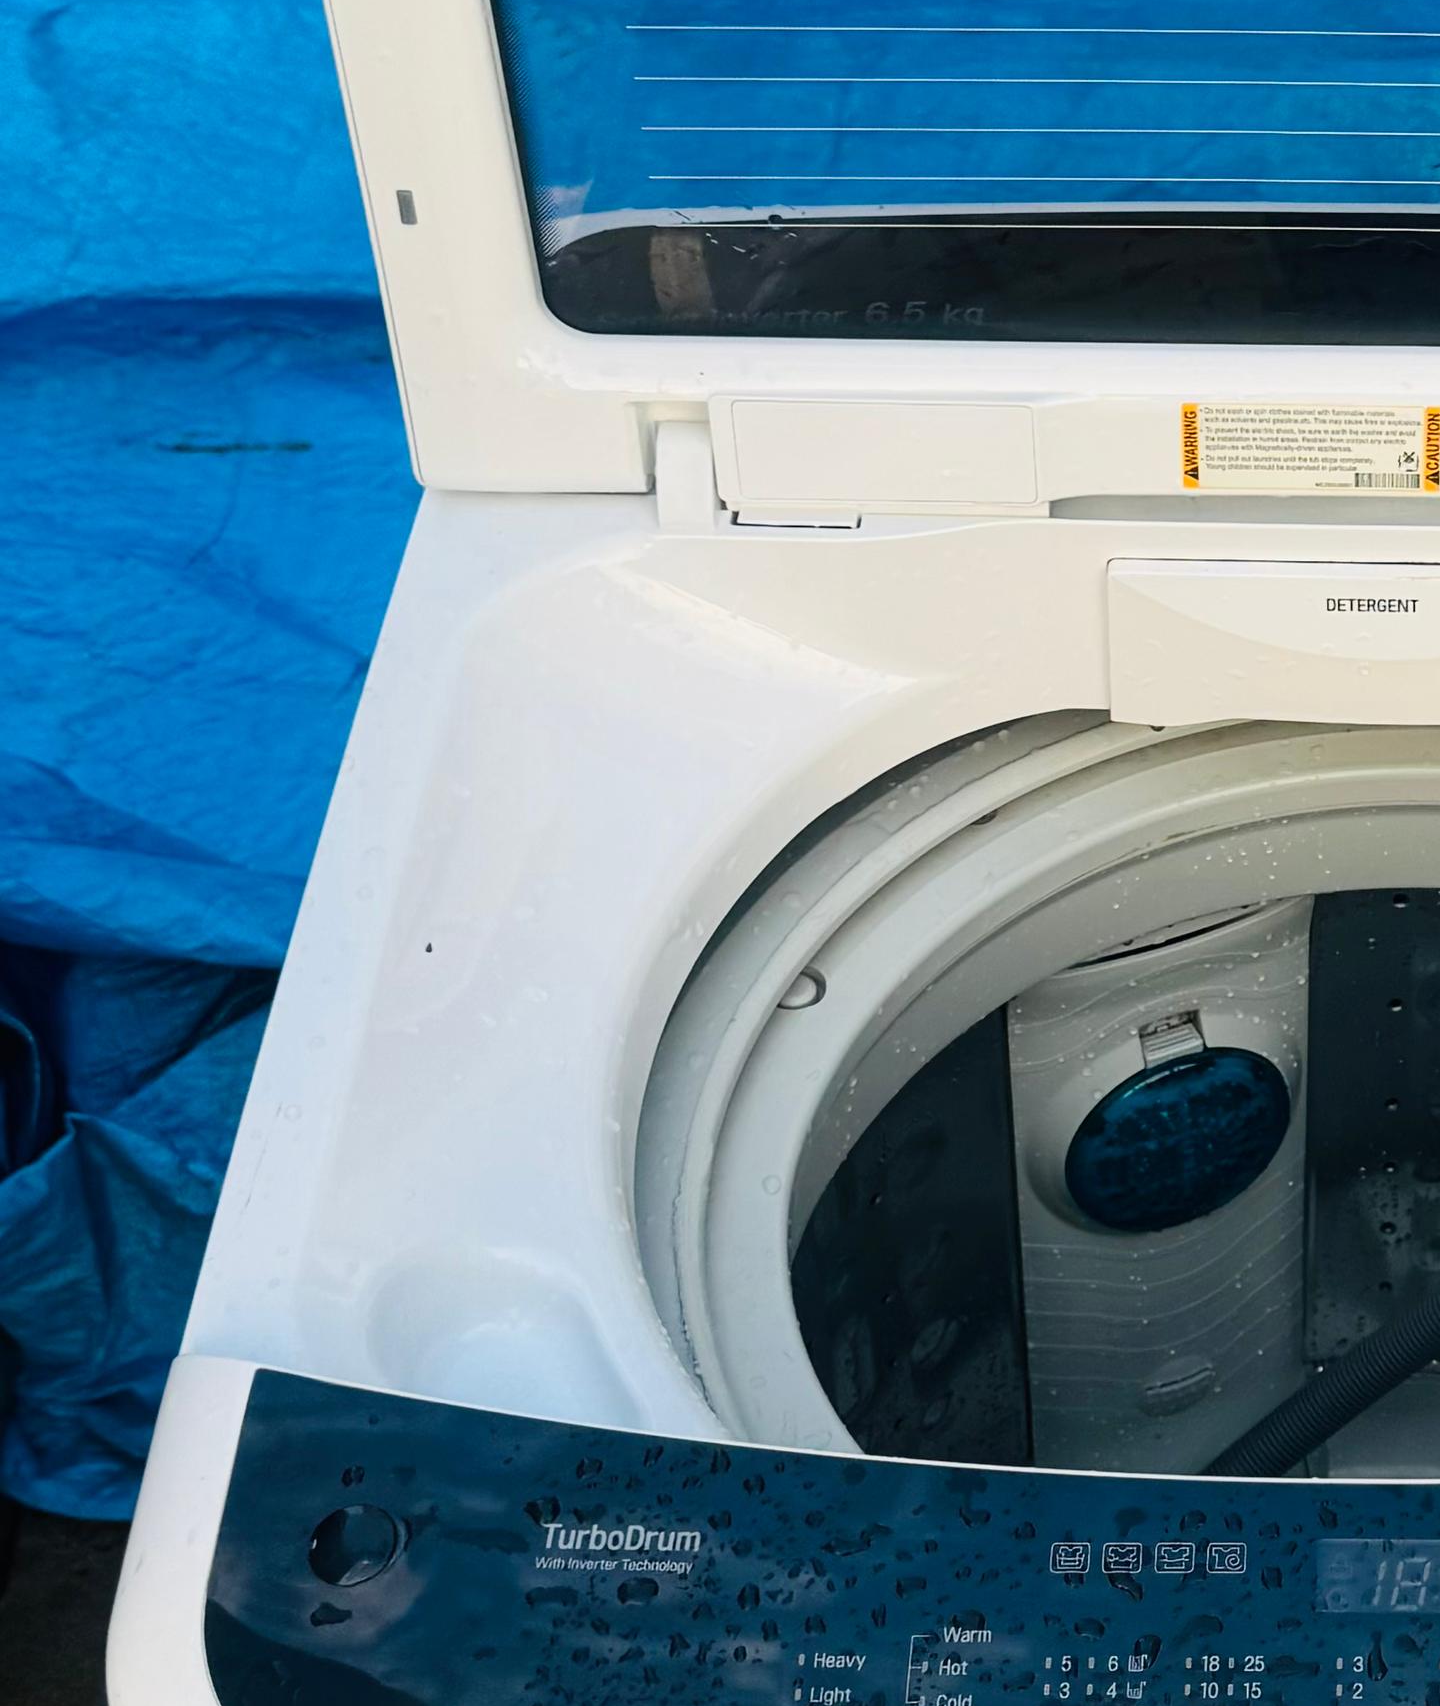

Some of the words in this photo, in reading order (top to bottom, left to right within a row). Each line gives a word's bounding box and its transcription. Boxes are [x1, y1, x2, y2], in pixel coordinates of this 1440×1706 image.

[1184, 410, 1198, 468] WARNING
[1426, 413, 1440, 470] CAUTION
[1326, 598, 1420, 614] DETERGENT
[542, 1522, 701, 1554] TurboDrum
[535, 1555, 565, 1572] With
[567, 1556, 618, 1572] Inverter
[620, 1558, 694, 1575] Technology
[943, 1626, 992, 1644] Warm
[813, 1651, 866, 1672] Heavy
[938, 1659, 968, 1677] Hot
[1061, 1655, 1071, 1673] 5
[1108, 1655, 1119, 1673] 6
[1201, 1656, 1221, 1673] 18
[1243, 1656, 1265, 1673] 25
[1352, 1656, 1364, 1673] 3
[809, 1685, 852, 1706] Light
[1059, 1683, 1070, 1700] 3
[1106, 1683, 1118, 1700] 4
[1200, 1683, 1219, 1700] 10
[1243, 1683, 1263, 1700] 15
[1351, 1684, 1364, 1700] 2
